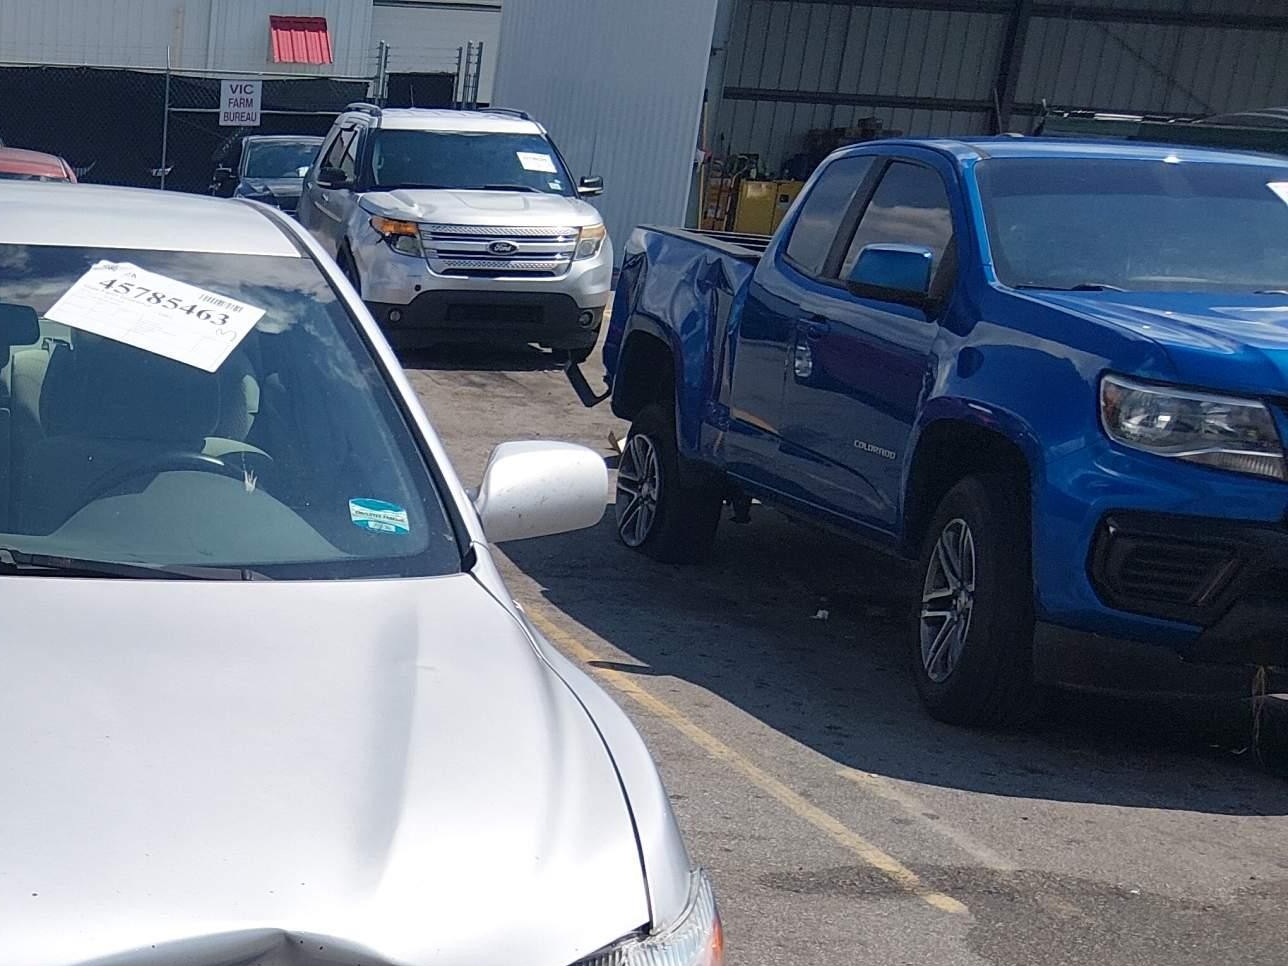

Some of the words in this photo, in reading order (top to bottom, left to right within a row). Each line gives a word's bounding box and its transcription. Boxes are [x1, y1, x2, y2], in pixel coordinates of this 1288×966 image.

[229, 84, 254, 95] VIC
[228, 97, 254, 108] FARM
[223, 111, 257, 122] BUREAU
[98, 278, 230, 327] 45785463
[854, 439, 896, 460] COLORADO
